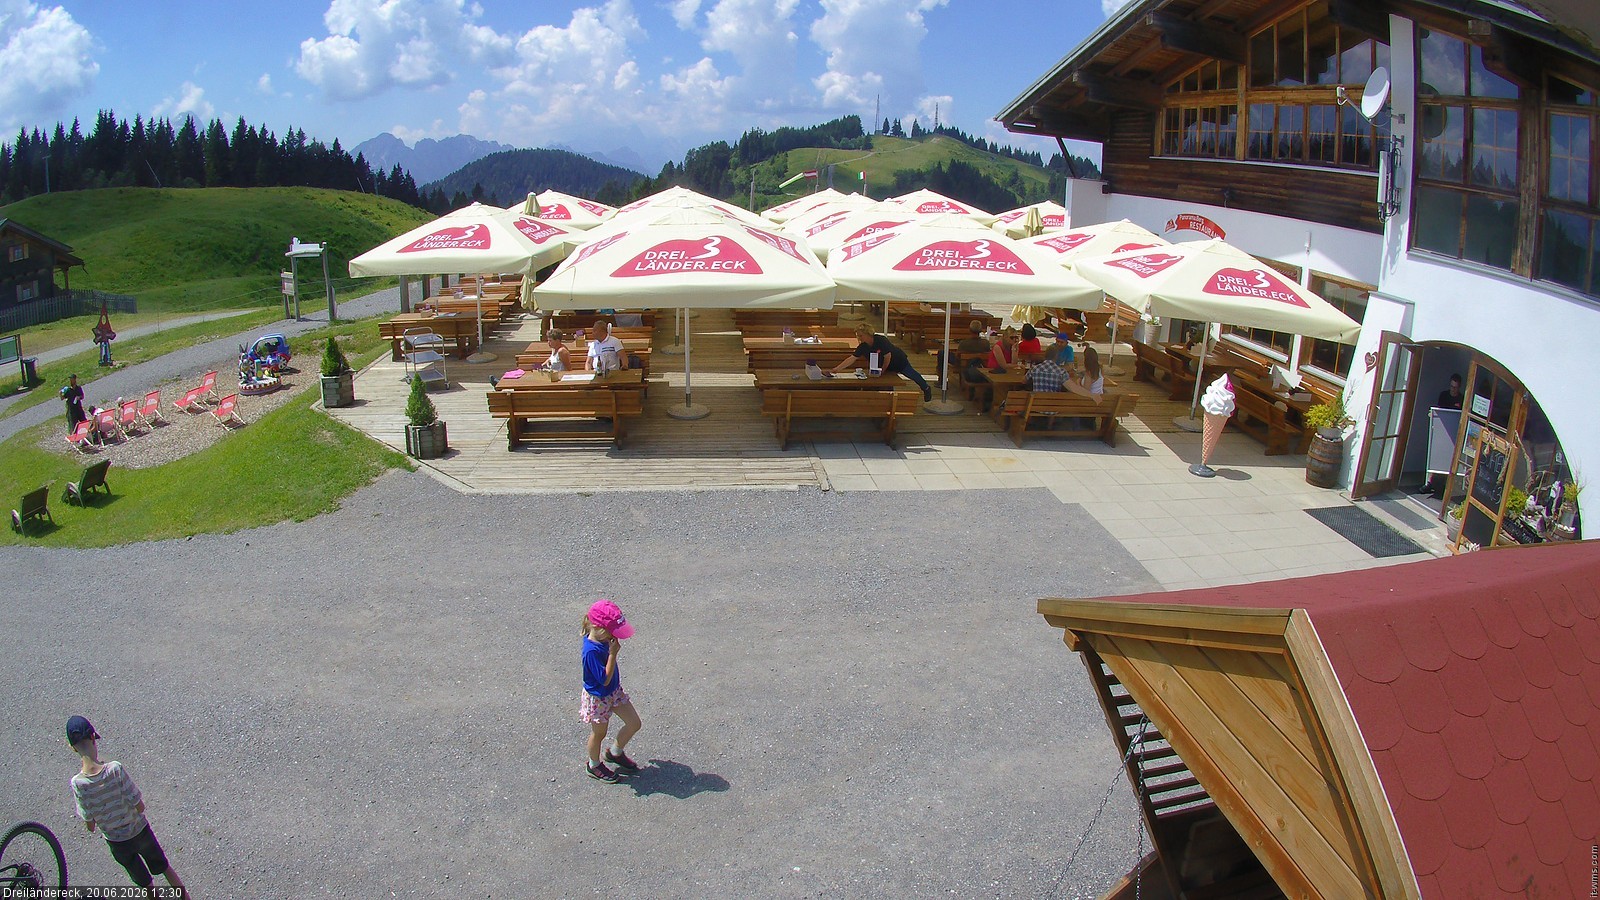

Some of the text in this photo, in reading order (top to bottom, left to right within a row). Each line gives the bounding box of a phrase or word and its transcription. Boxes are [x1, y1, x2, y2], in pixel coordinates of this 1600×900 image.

[645, 251, 689, 260] DREI.
[922, 249, 964, 258] DREI.
[635, 259, 747, 271] LÄNDER.ECK
[915, 256, 1018, 270] LÄNDER.ECK
[1217, 274, 1252, 287] DREI.
[1217, 281, 1296, 303] LÄNDER.ECK
